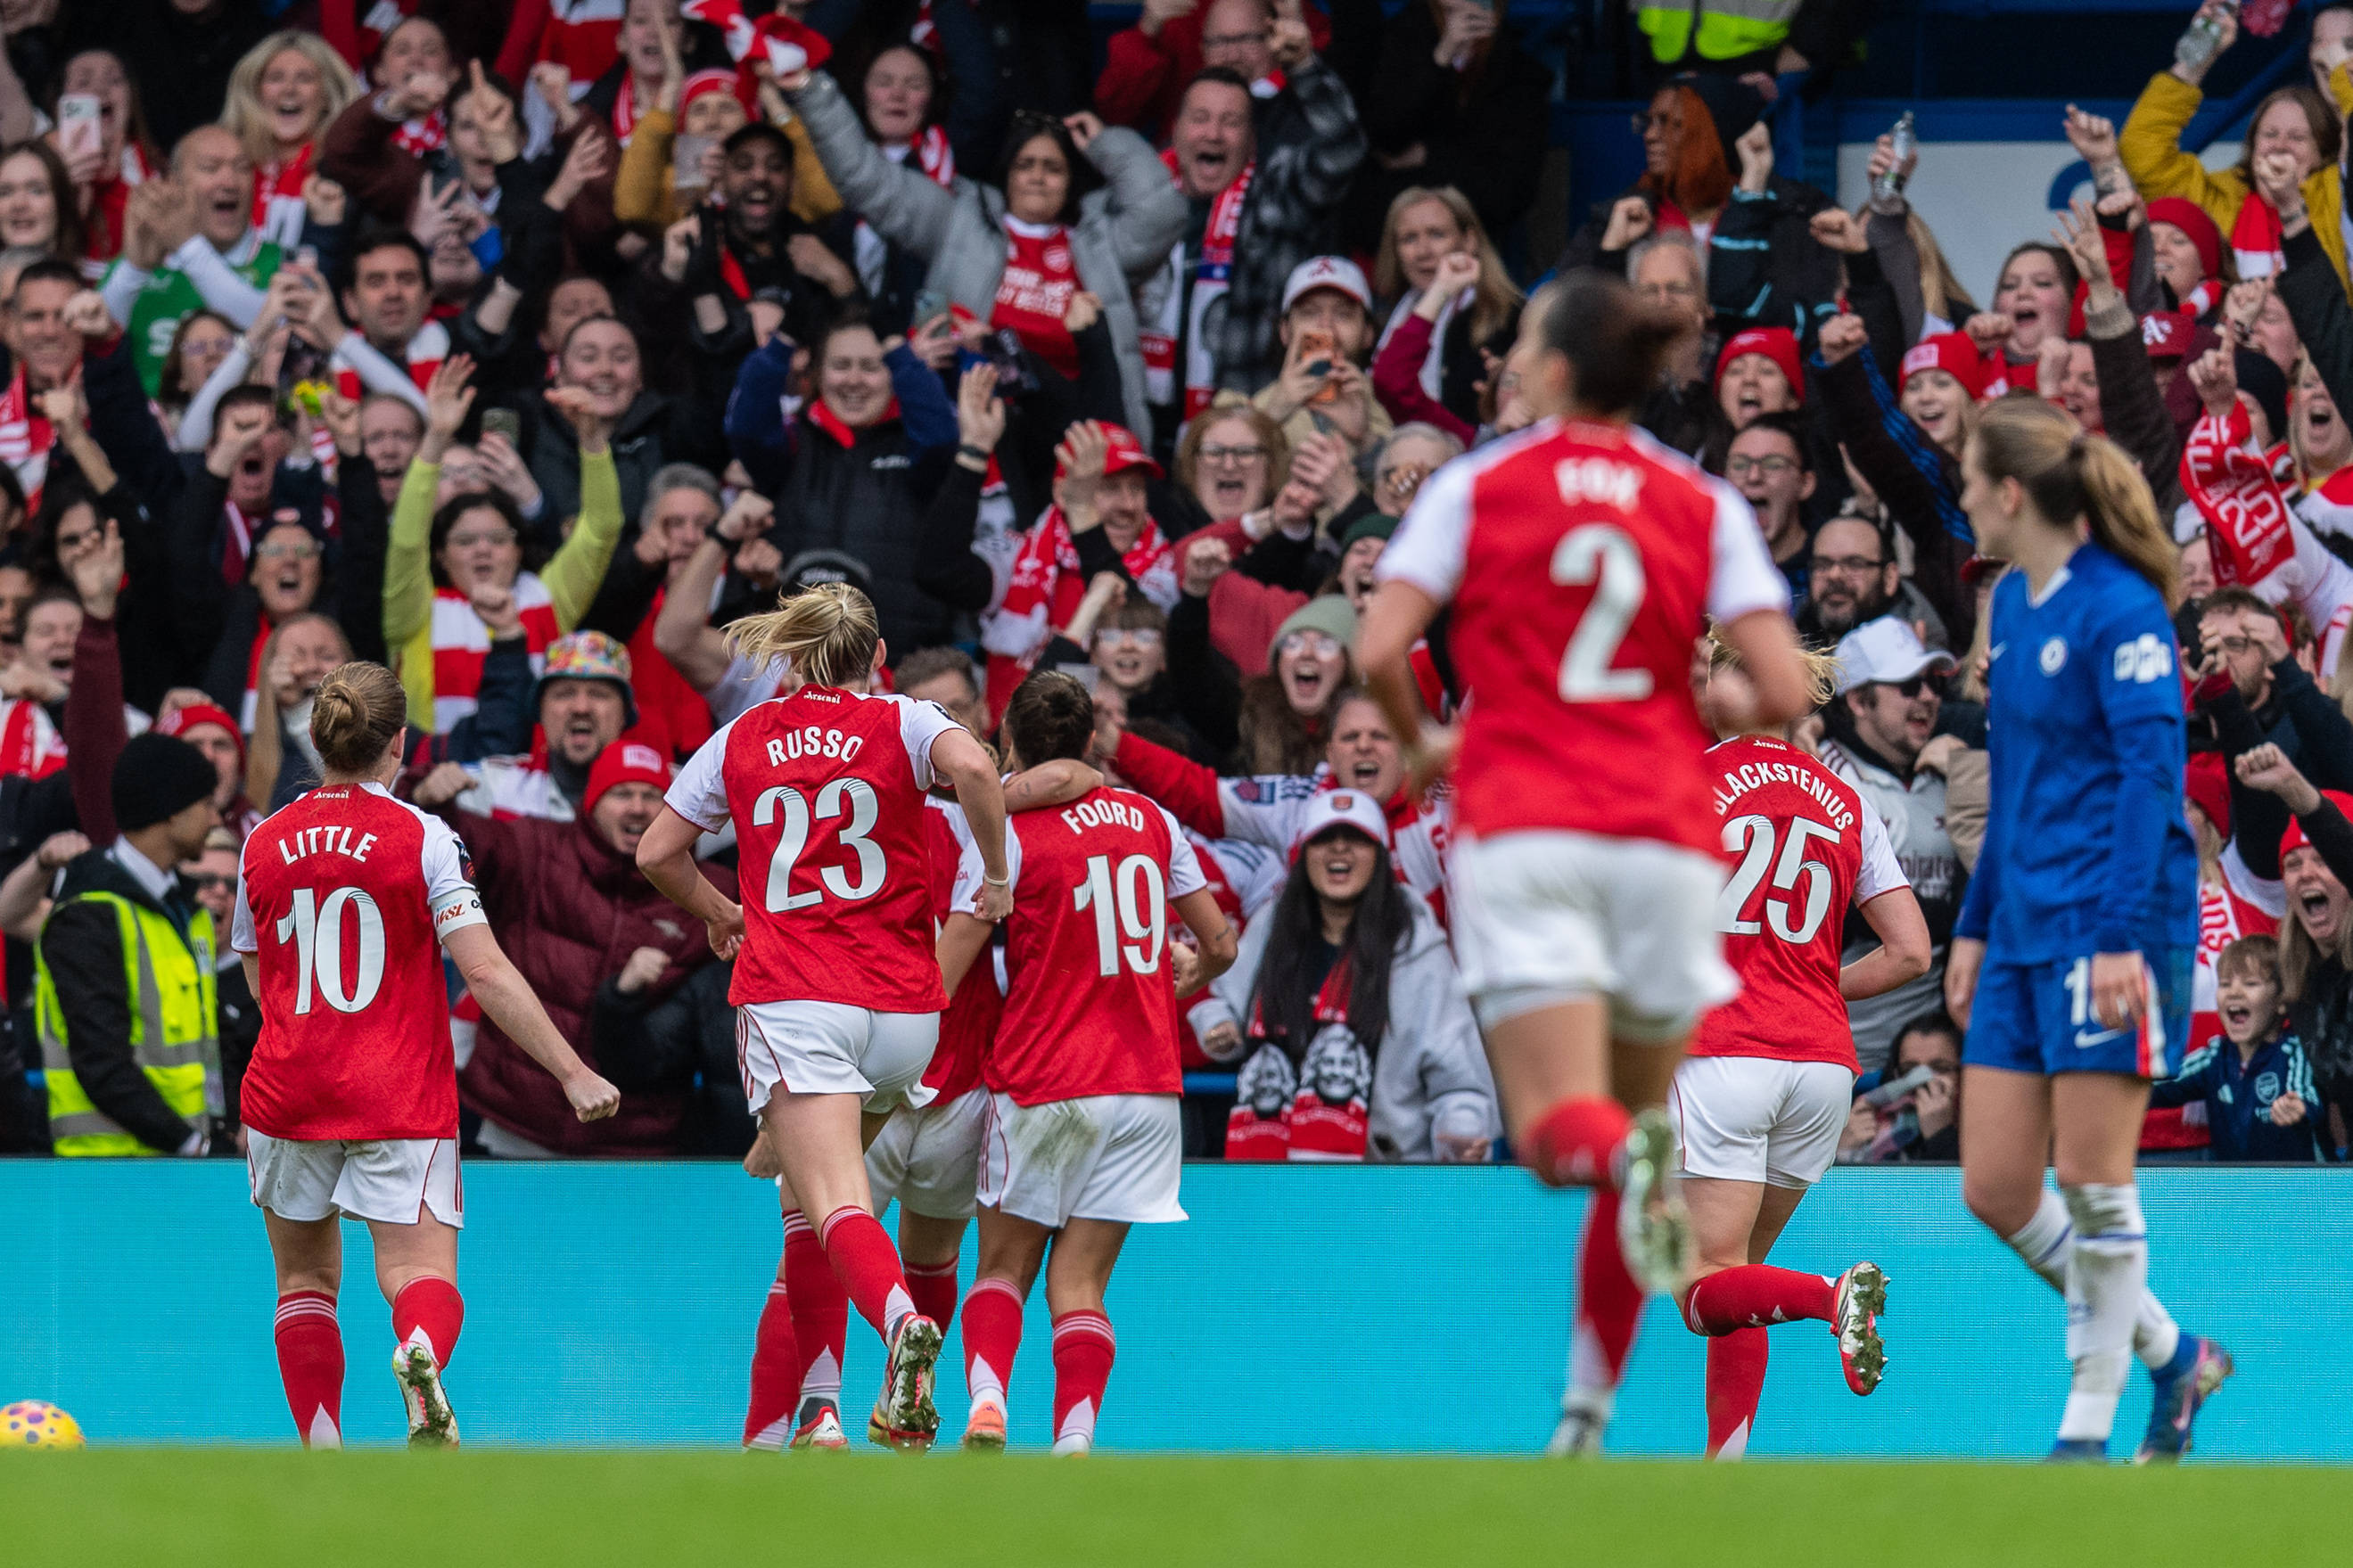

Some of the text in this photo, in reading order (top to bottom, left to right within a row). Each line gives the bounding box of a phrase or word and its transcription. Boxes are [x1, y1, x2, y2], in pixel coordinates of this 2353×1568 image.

[1554, 456, 1646, 514] FOX
[2217, 478, 2280, 548] 25
[1549, 521, 1656, 704] 2
[803, 691, 841, 704] Arsenal
[766, 726, 864, 768] RUSSO
[313, 789, 350, 800] Arsenal
[1060, 799, 1144, 834] FOORD
[278, 825, 378, 866] LITTLE
[753, 776, 887, 914] 23
[1716, 813, 1841, 945] 25
[1073, 853, 1165, 977] 19
[276, 885, 387, 1015] 10
